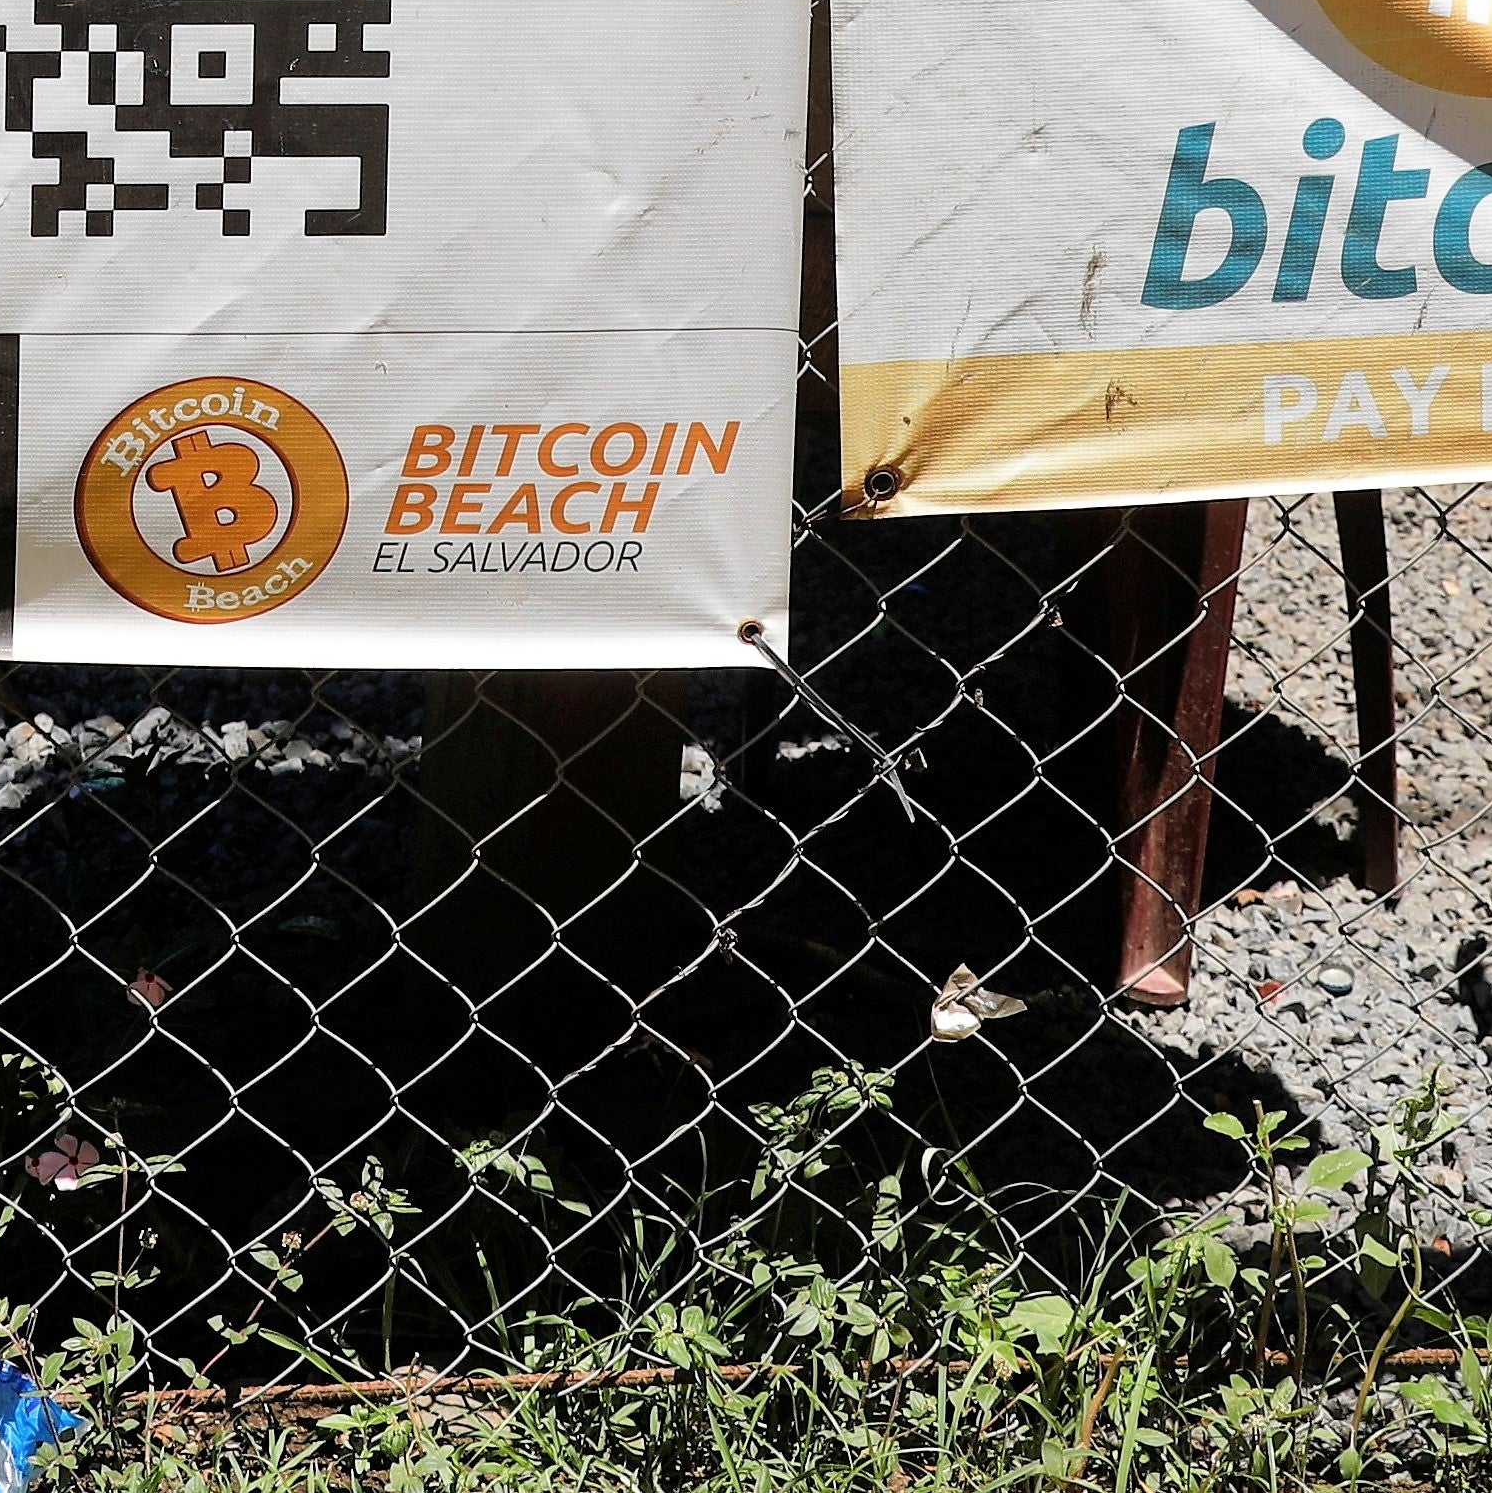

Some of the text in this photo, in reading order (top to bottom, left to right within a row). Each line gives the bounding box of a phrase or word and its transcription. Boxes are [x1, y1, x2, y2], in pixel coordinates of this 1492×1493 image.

[1258, 366, 1452, 446] PAY
[400, 420, 742, 478] BITCOIN
[382, 481, 662, 536] BEACH
[371, 540, 644, 574] EL SALVADOR
